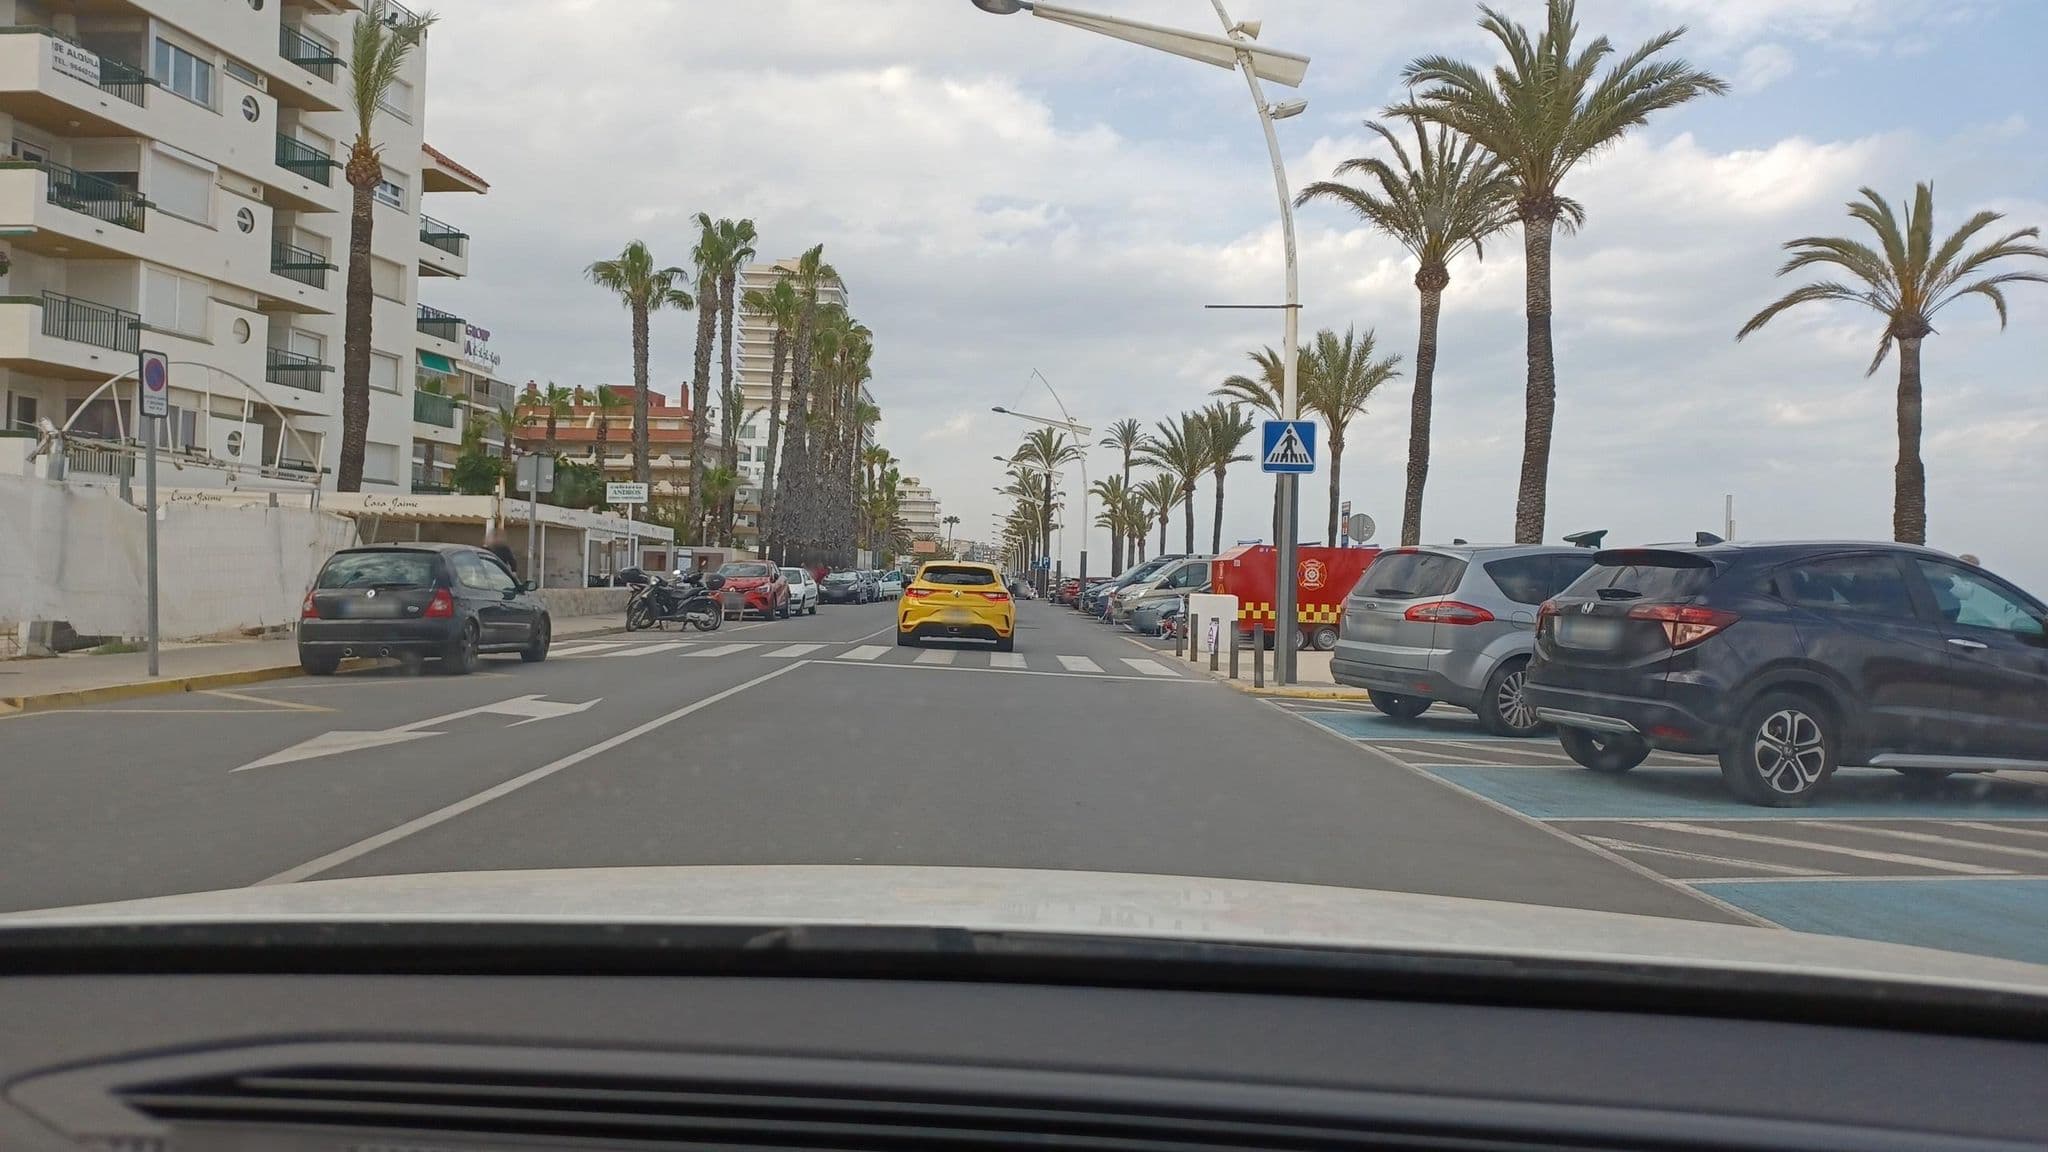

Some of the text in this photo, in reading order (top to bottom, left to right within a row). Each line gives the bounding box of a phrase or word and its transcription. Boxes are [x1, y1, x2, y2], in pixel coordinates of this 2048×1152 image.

[55, 42, 99, 68] SE ALQUILA
[171, 489, 222, 505] Casa Jaime
[364, 494, 418, 511] Casa Jaime
